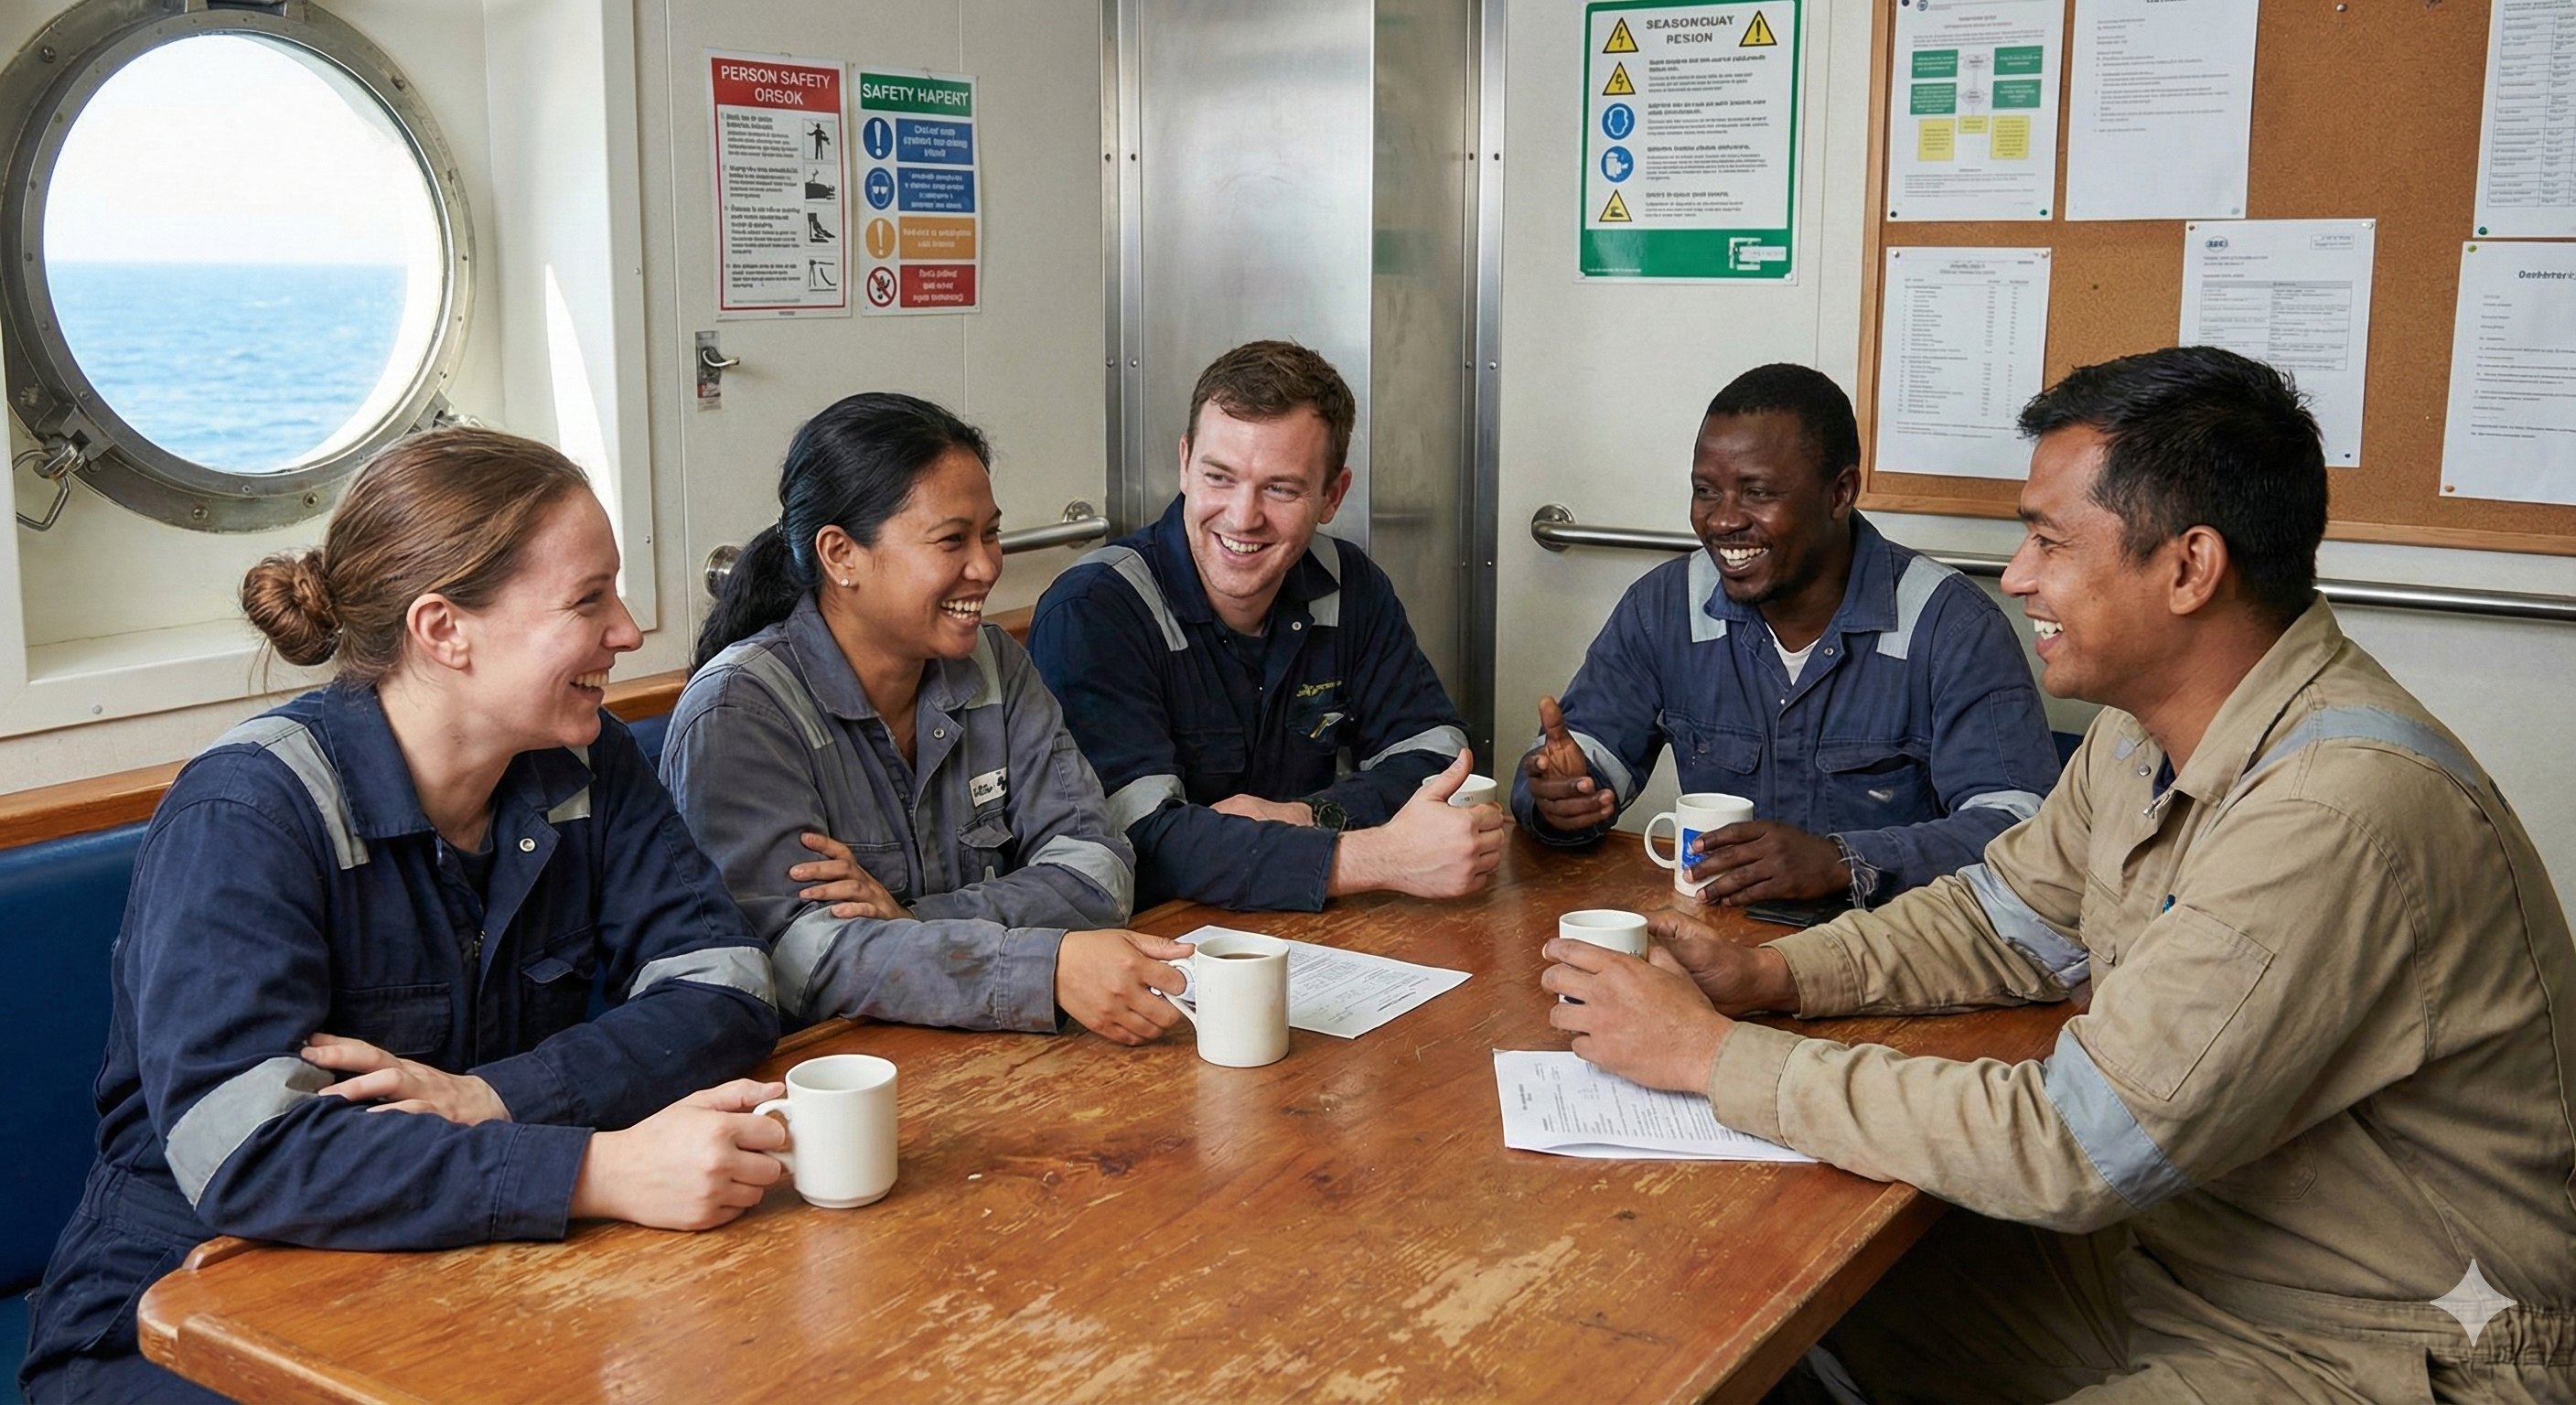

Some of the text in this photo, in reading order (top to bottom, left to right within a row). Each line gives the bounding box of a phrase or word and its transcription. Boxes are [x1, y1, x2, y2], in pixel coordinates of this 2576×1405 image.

[721, 66, 831, 89] PERSON SAFETY
[755, 87, 803, 105] ORSOK
[862, 83, 915, 102] SAFETY
